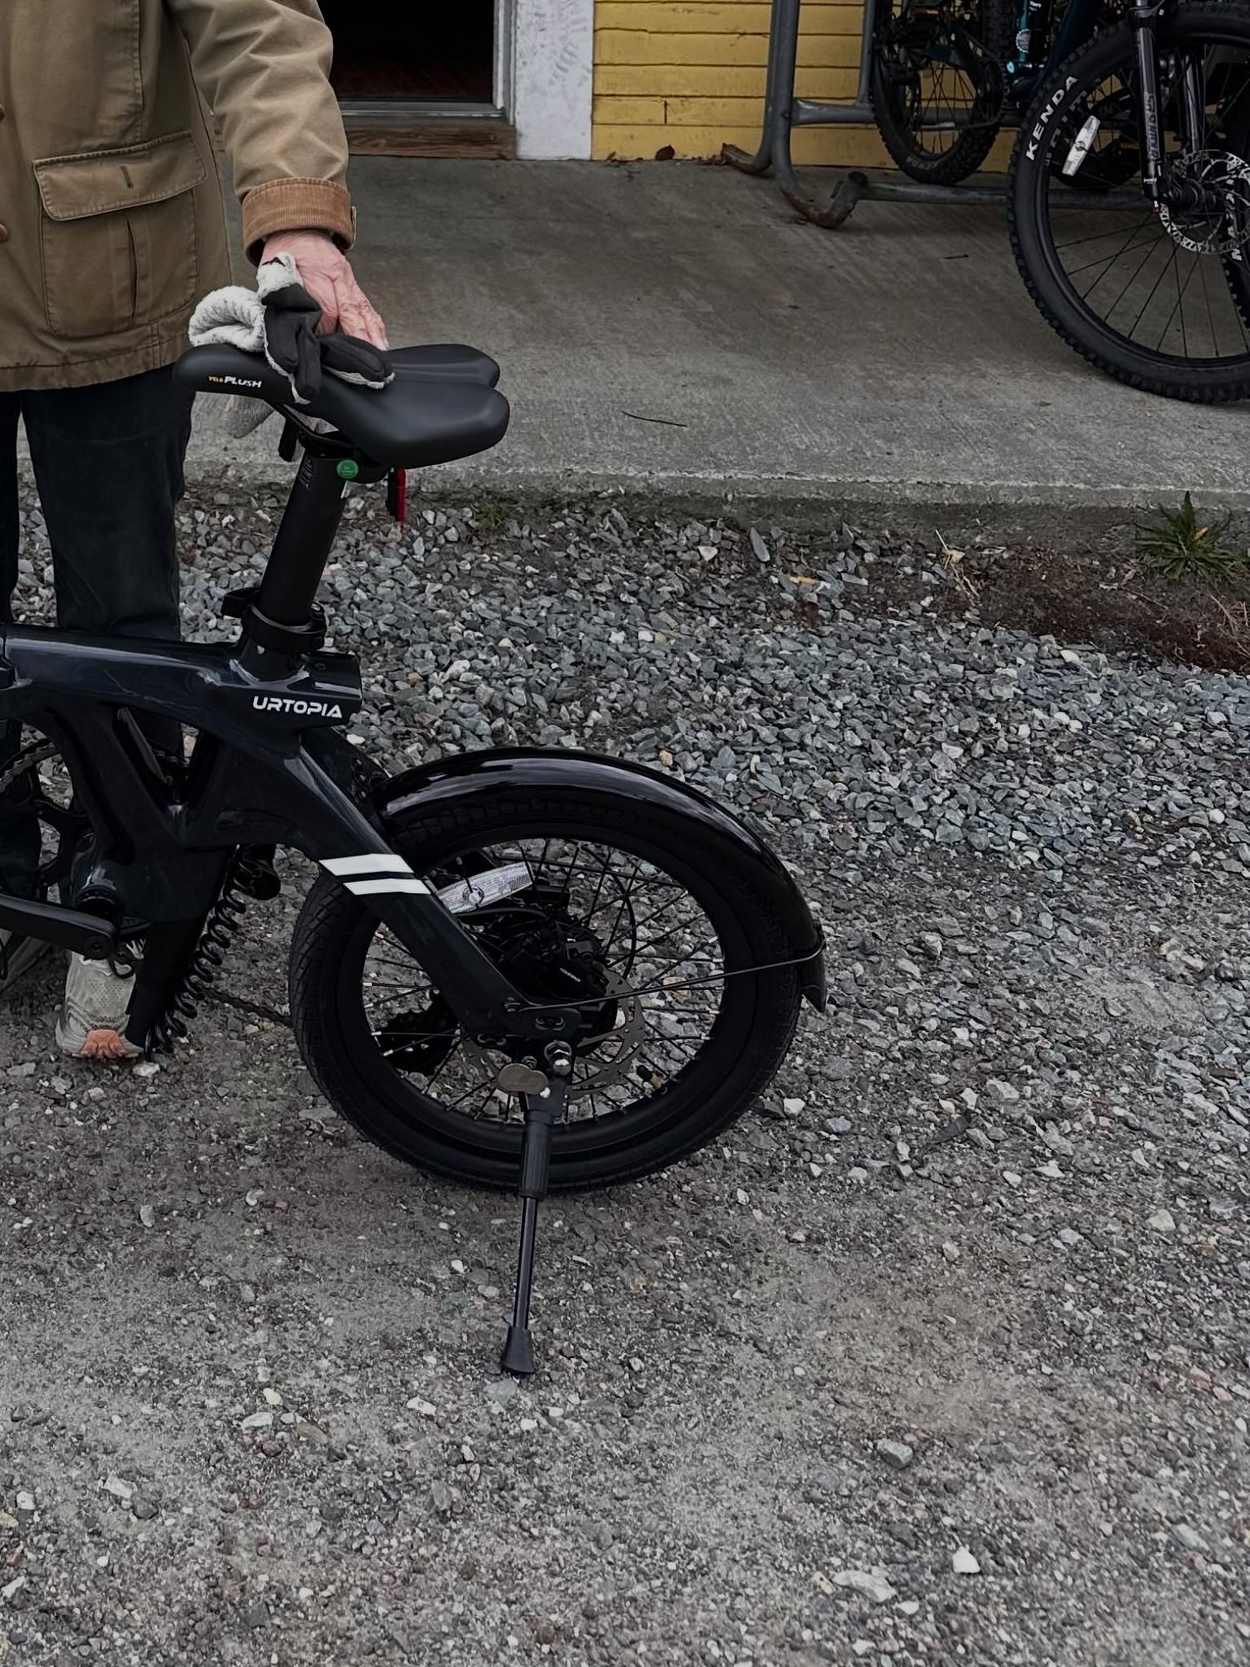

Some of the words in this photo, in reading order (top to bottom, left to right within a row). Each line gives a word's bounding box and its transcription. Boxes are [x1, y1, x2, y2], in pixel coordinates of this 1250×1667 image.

[1025, 76, 1078, 161] KENDA
[224, 375, 262, 388] PLUSH
[252, 696, 342, 719] URTOPIA
